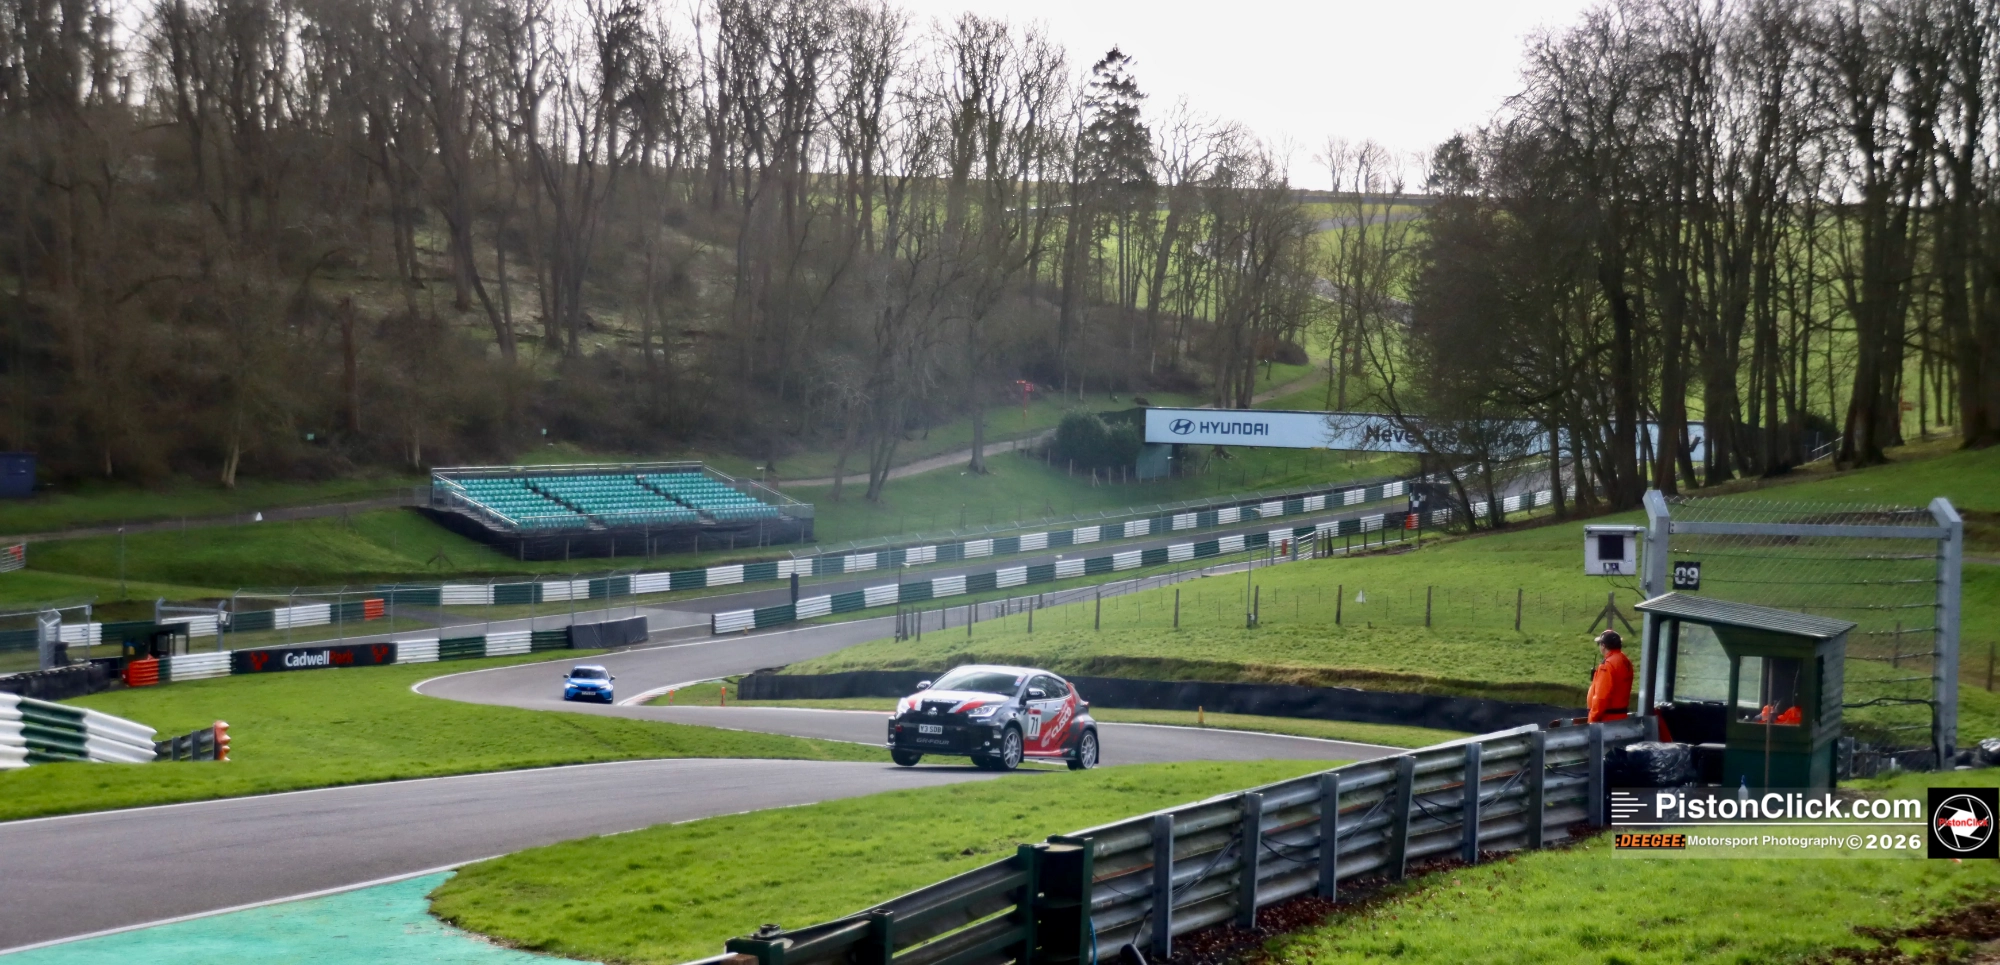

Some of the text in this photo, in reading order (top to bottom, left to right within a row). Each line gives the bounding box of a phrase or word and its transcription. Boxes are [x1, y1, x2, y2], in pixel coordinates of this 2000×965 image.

[1200, 421, 1268, 436] HYUNDAI
[1366, 424, 1420, 443] Neve
[1674, 566, 1698, 585] 09
[1030, 716, 1038, 735] 71
